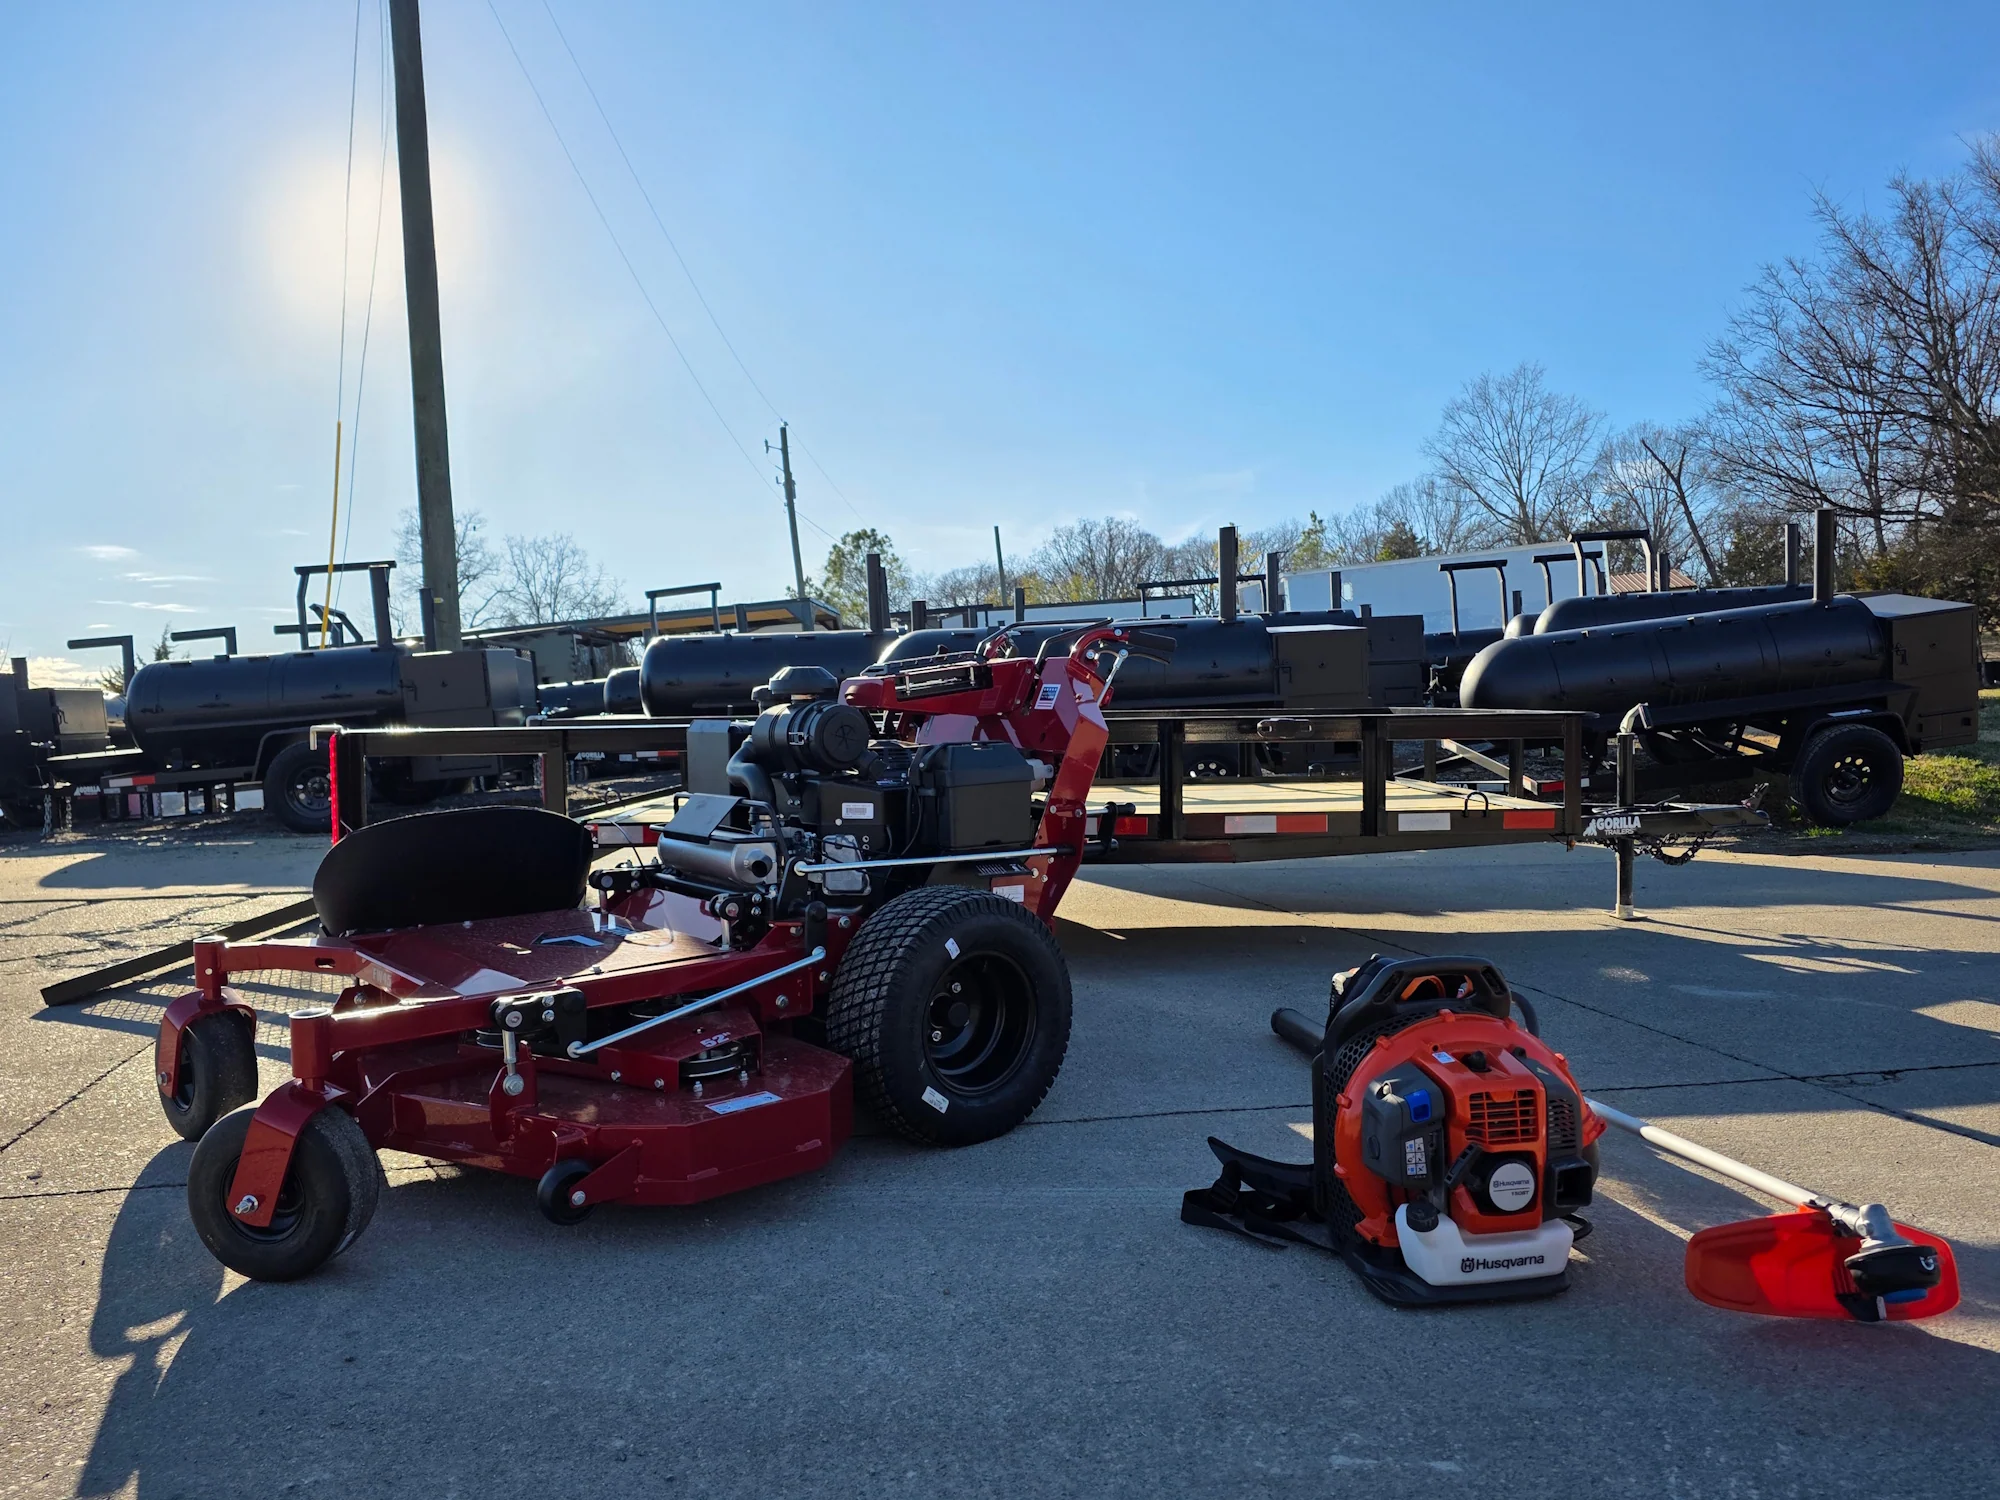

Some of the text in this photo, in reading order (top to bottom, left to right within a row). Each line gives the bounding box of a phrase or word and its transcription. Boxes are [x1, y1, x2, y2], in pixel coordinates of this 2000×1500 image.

[1597, 816, 1641, 830] GORILLA
[1604, 828, 1635, 836] TRAILERS
[700, 1031, 731, 1048] 52"
[1499, 1179, 1530, 1187] Husqvarna
[1476, 1254, 1545, 1271] Husqvarna
